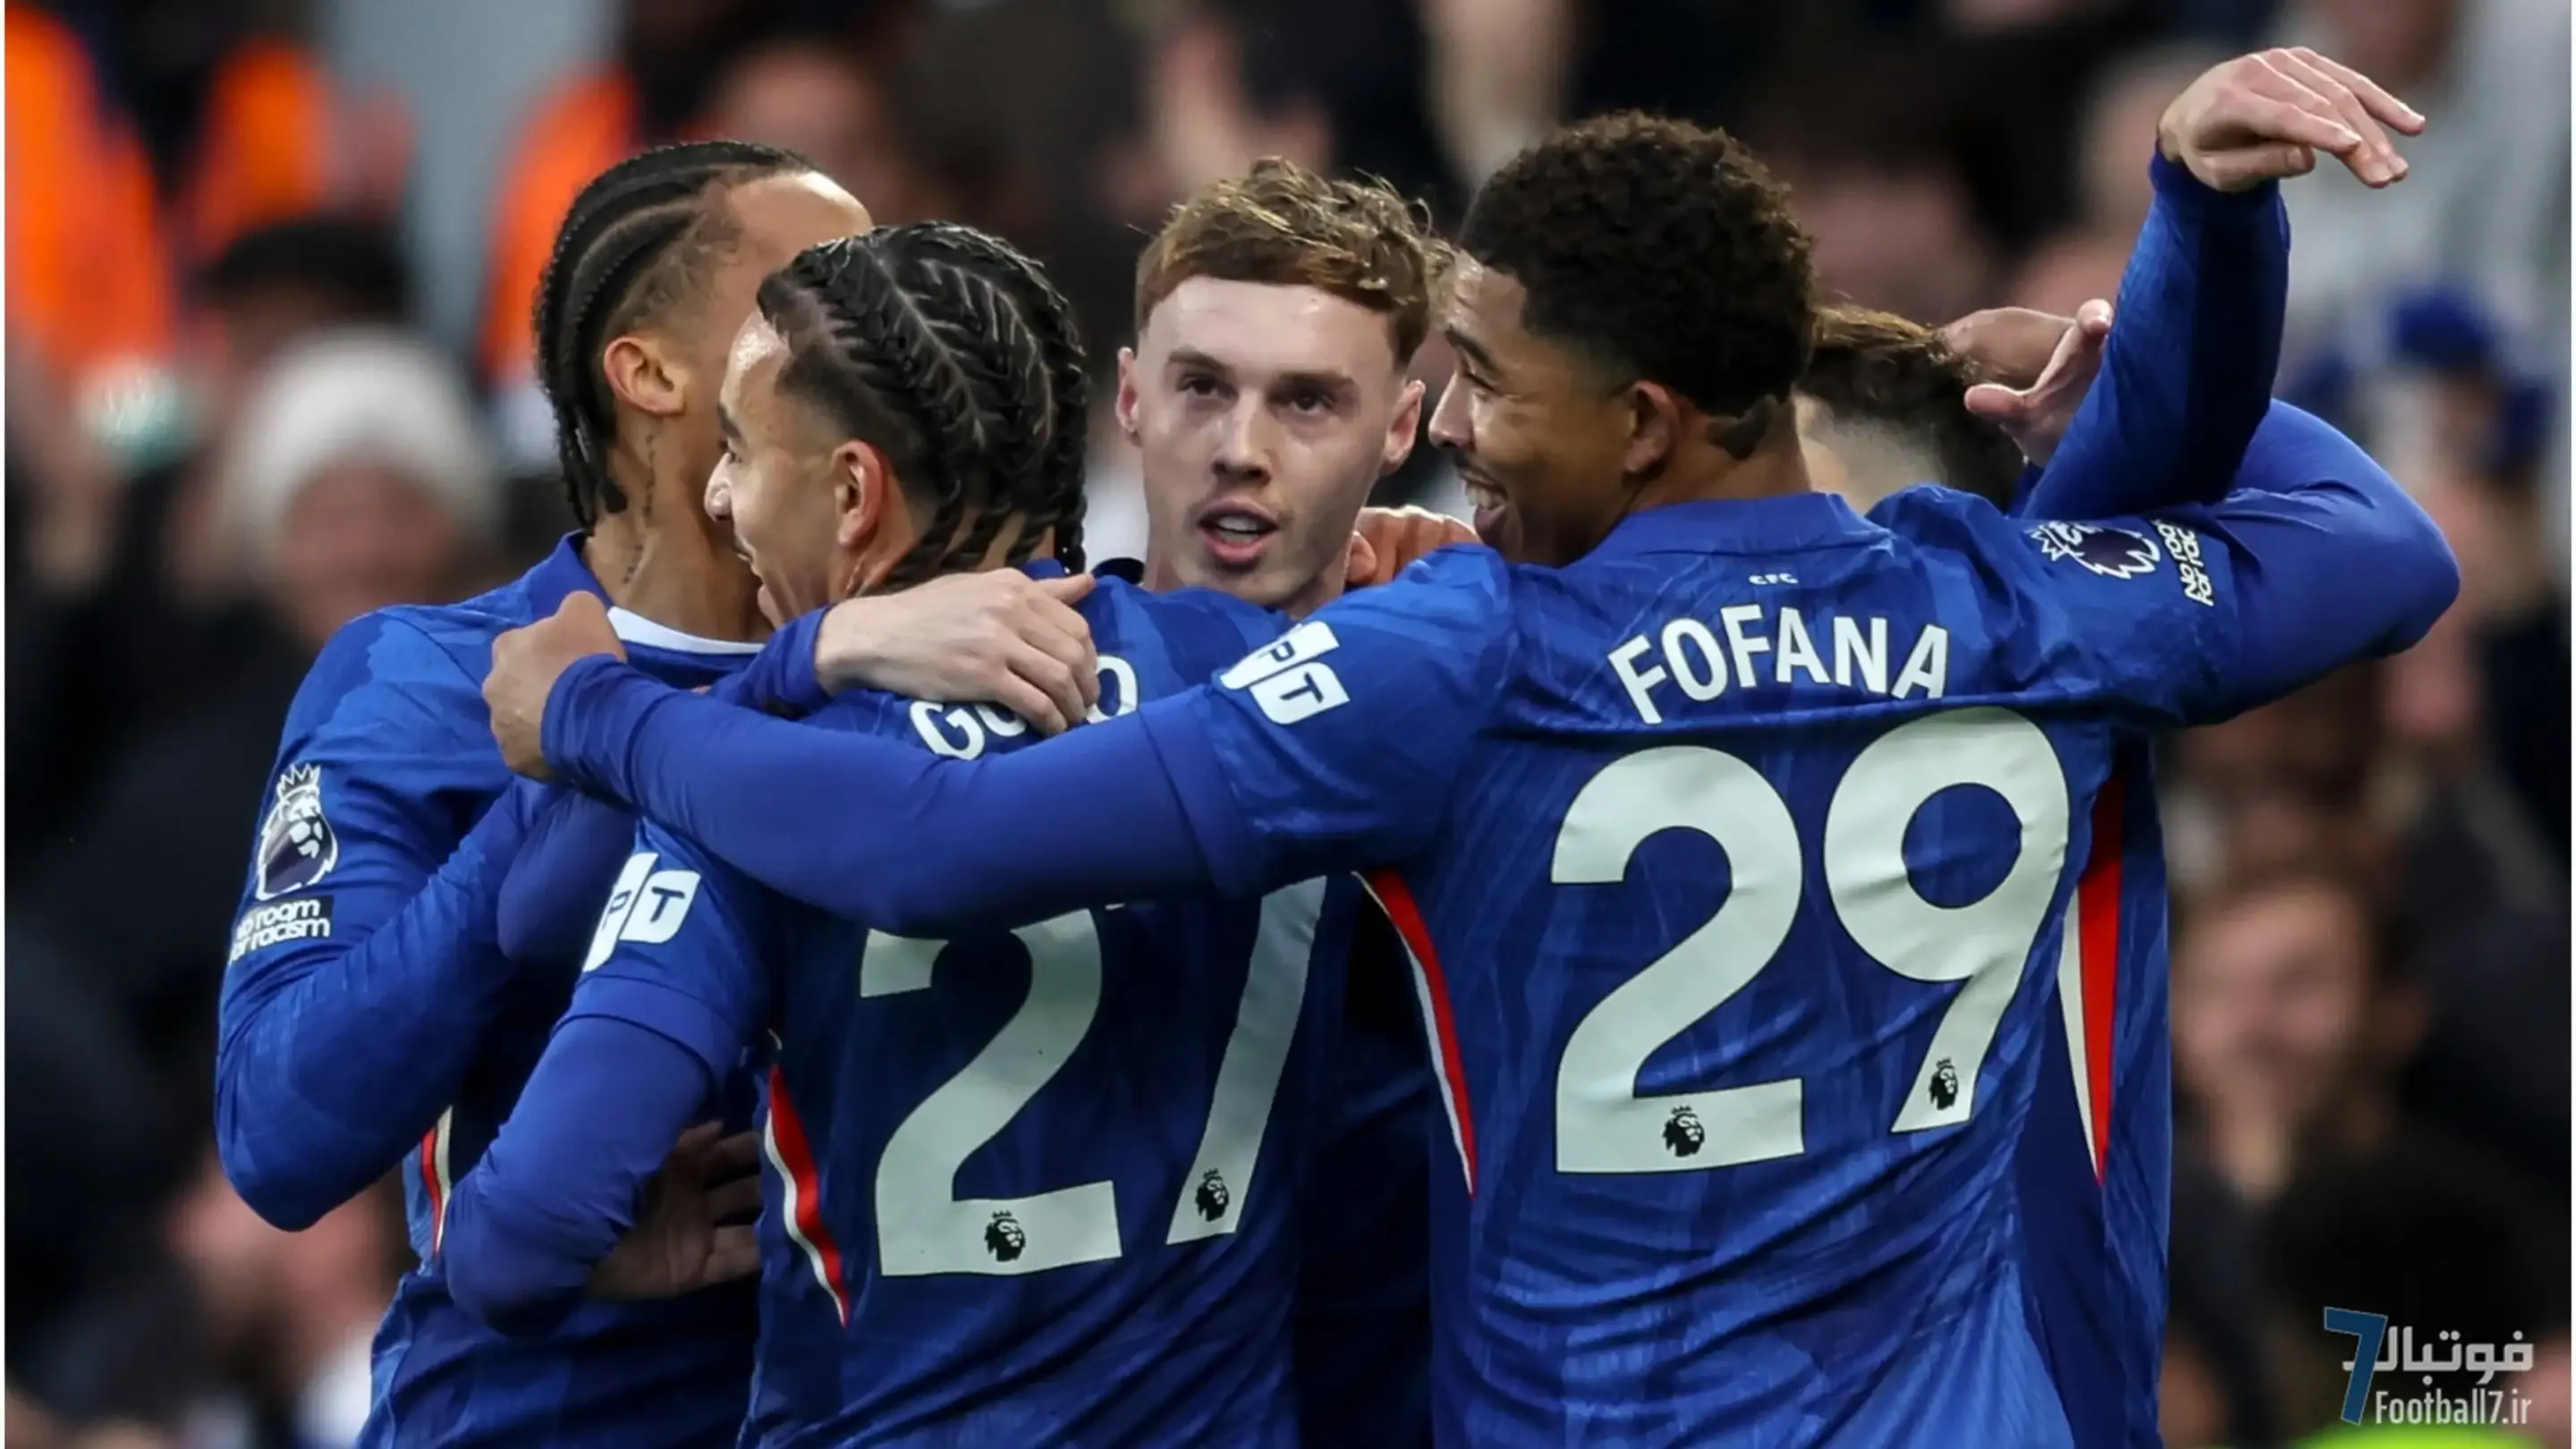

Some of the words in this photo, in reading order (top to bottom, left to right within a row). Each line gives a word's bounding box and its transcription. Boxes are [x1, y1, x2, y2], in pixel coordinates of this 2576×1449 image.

[2150, 520, 2188, 562] roo
[1607, 604, 1949, 724] FOFANA
[251, 918, 331, 951] racism
[254, 899, 321, 930] room
[1550, 706, 2070, 1174] 29
[860, 875, 1326, 1276] 27
